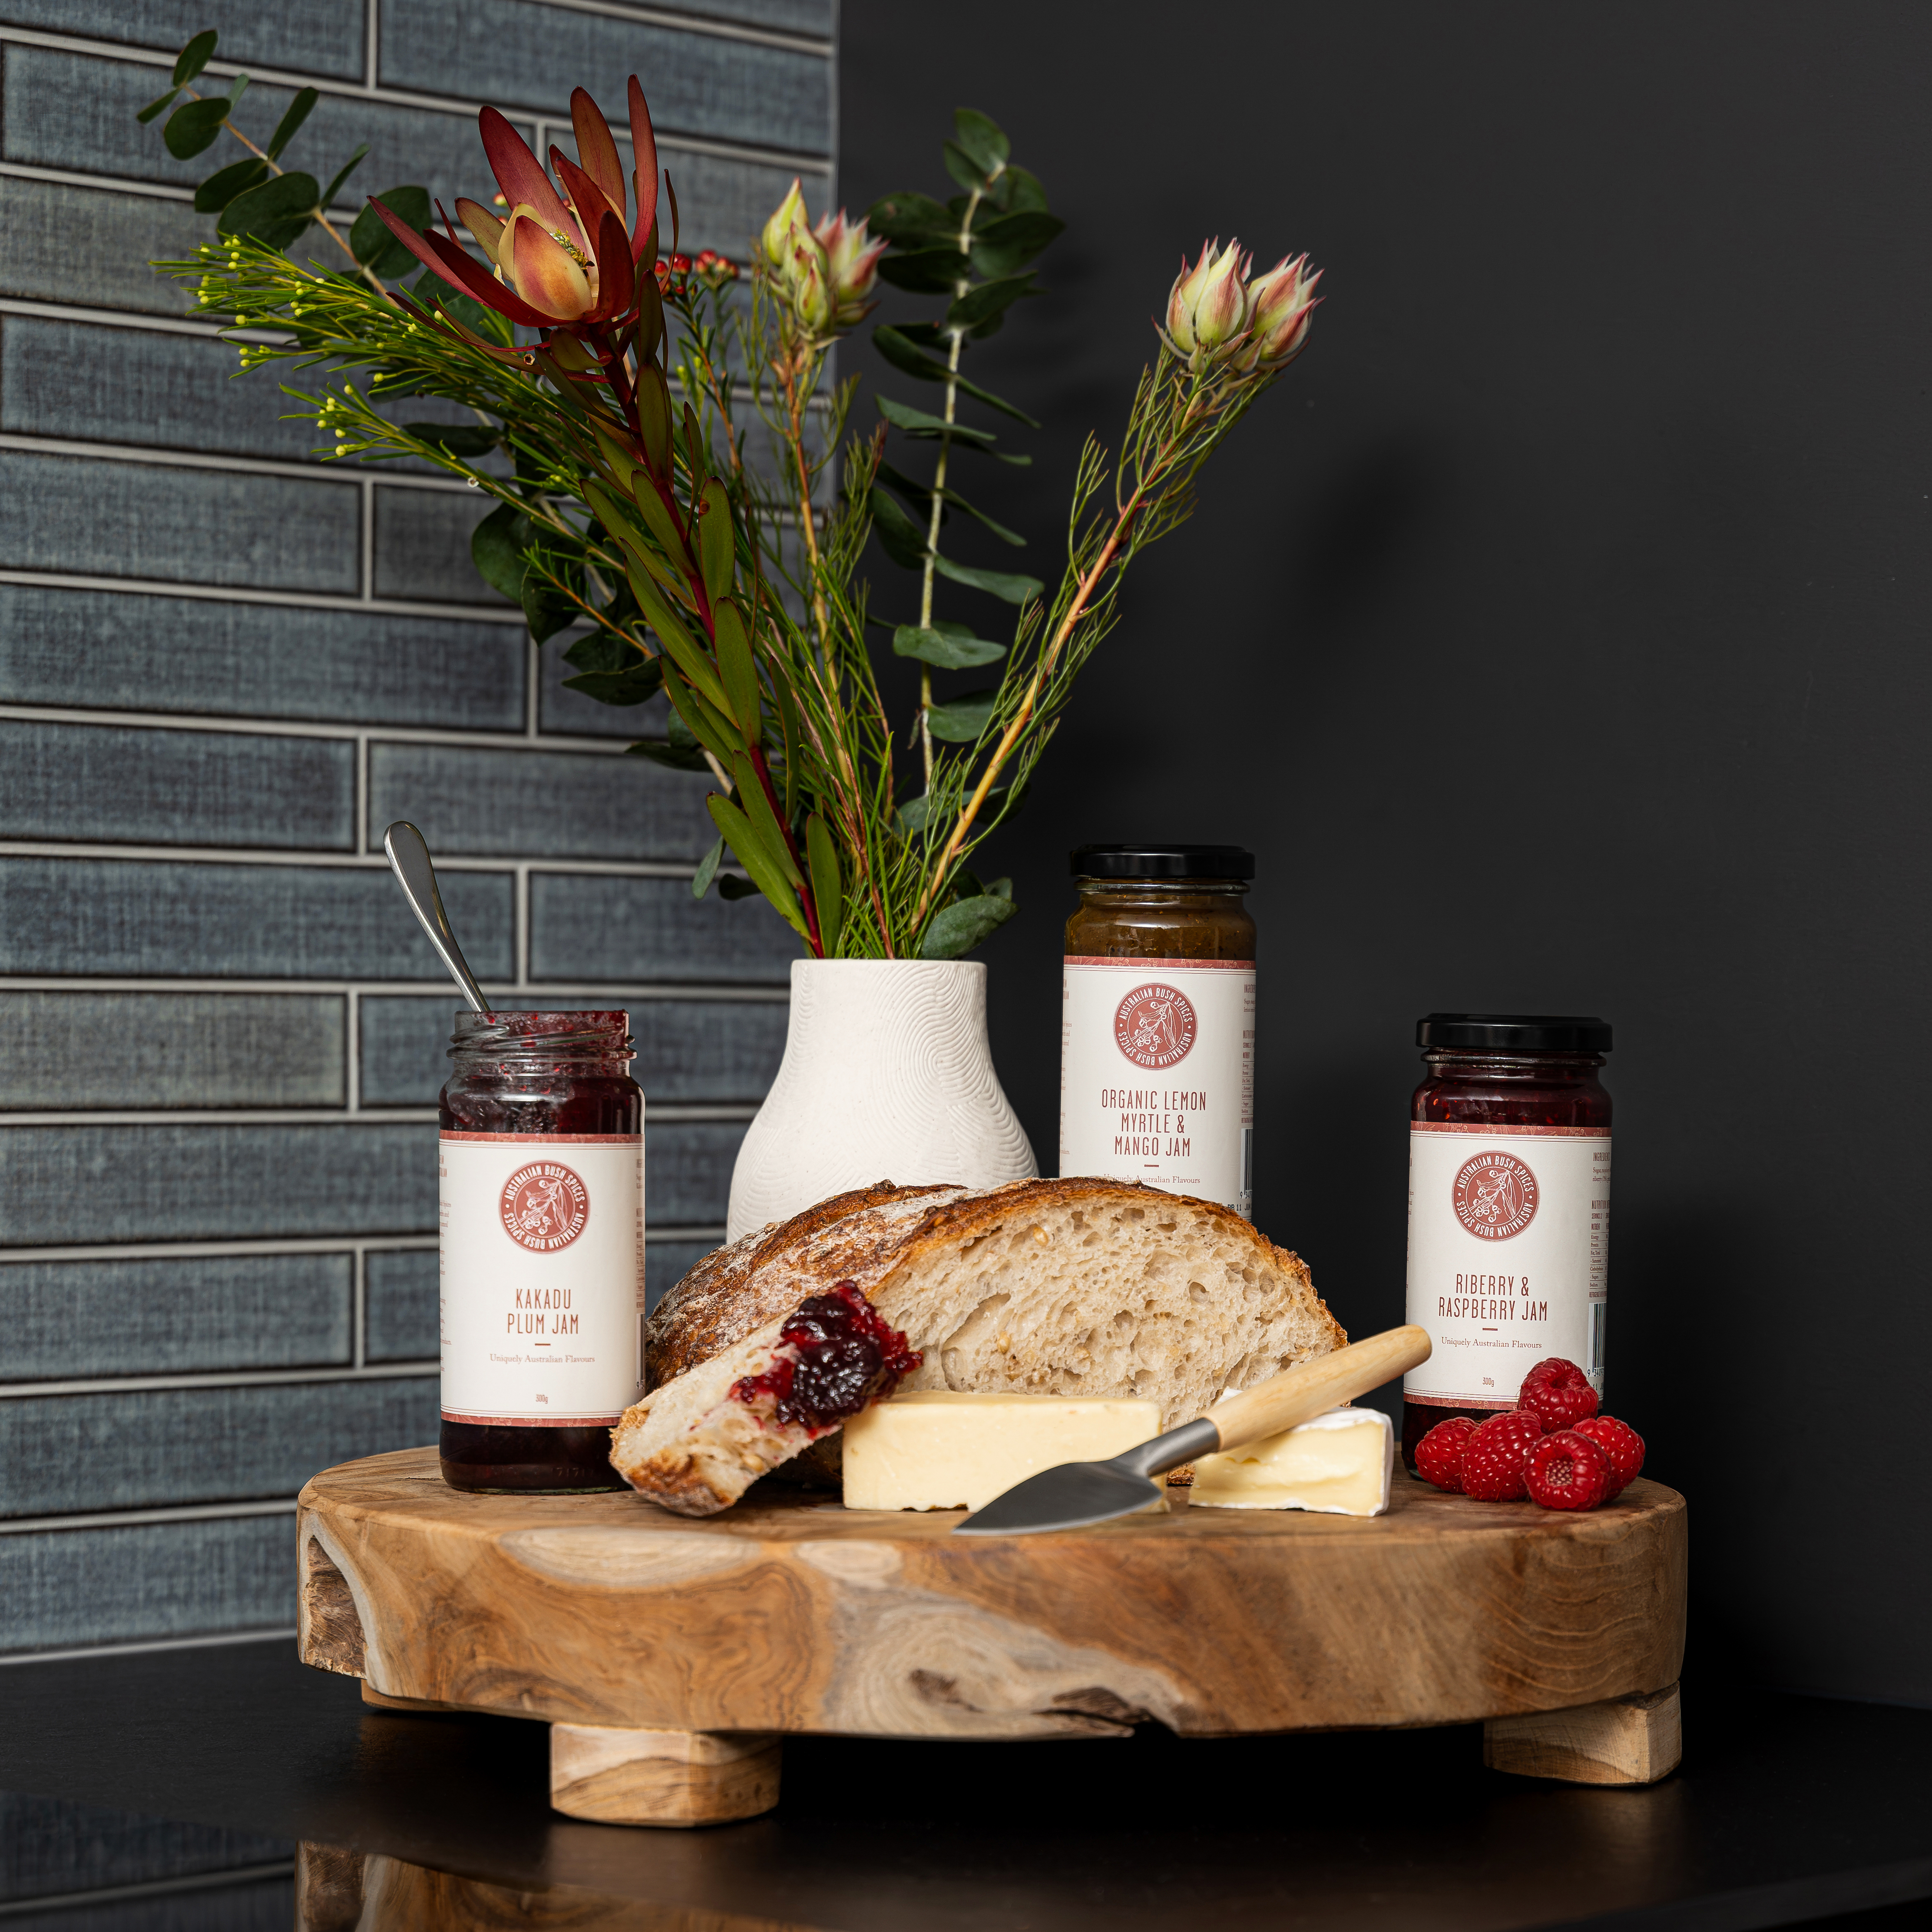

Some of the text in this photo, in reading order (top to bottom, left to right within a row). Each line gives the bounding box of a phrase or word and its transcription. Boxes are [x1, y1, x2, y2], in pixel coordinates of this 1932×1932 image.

[1119, 988, 1193, 1022] AUSTRALIAN BUSH SPICES
[1118, 1032, 1193, 1066] AUSTRALIAN BUSH SPICES
[1102, 1089, 1206, 1110] ORGANIC LEMON
[1121, 1113, 1184, 1133] MYRTLE &
[1115, 1136, 1190, 1157] MANGO JAM
[504, 1164, 585, 1202] AUSTRALIAN BUSH SPICES
[1457, 1155, 1534, 1192] AUSTRALIAN BUSH SPICES
[1456, 1201, 1534, 1237] AUSTRALIAN BUSH SPICES
[504, 1212, 585, 1249] AUSTRALIAN BUSH SPICES
[1456, 1274, 1529, 1296] RIBERRY &
[516, 1289, 571, 1309] KAKADU
[1439, 1297, 1547, 1321] RASPBERRY JAM
[507, 1313, 579, 1334] PLUM JAM
[1442, 1337, 1471, 1348] Uniquely
[1473, 1339, 1509, 1347] Australian
[490, 1353, 523, 1364] Uniquely
[1482, 1377, 1494, 1387] 300g
[536, 1394, 548, 1404] 300g
